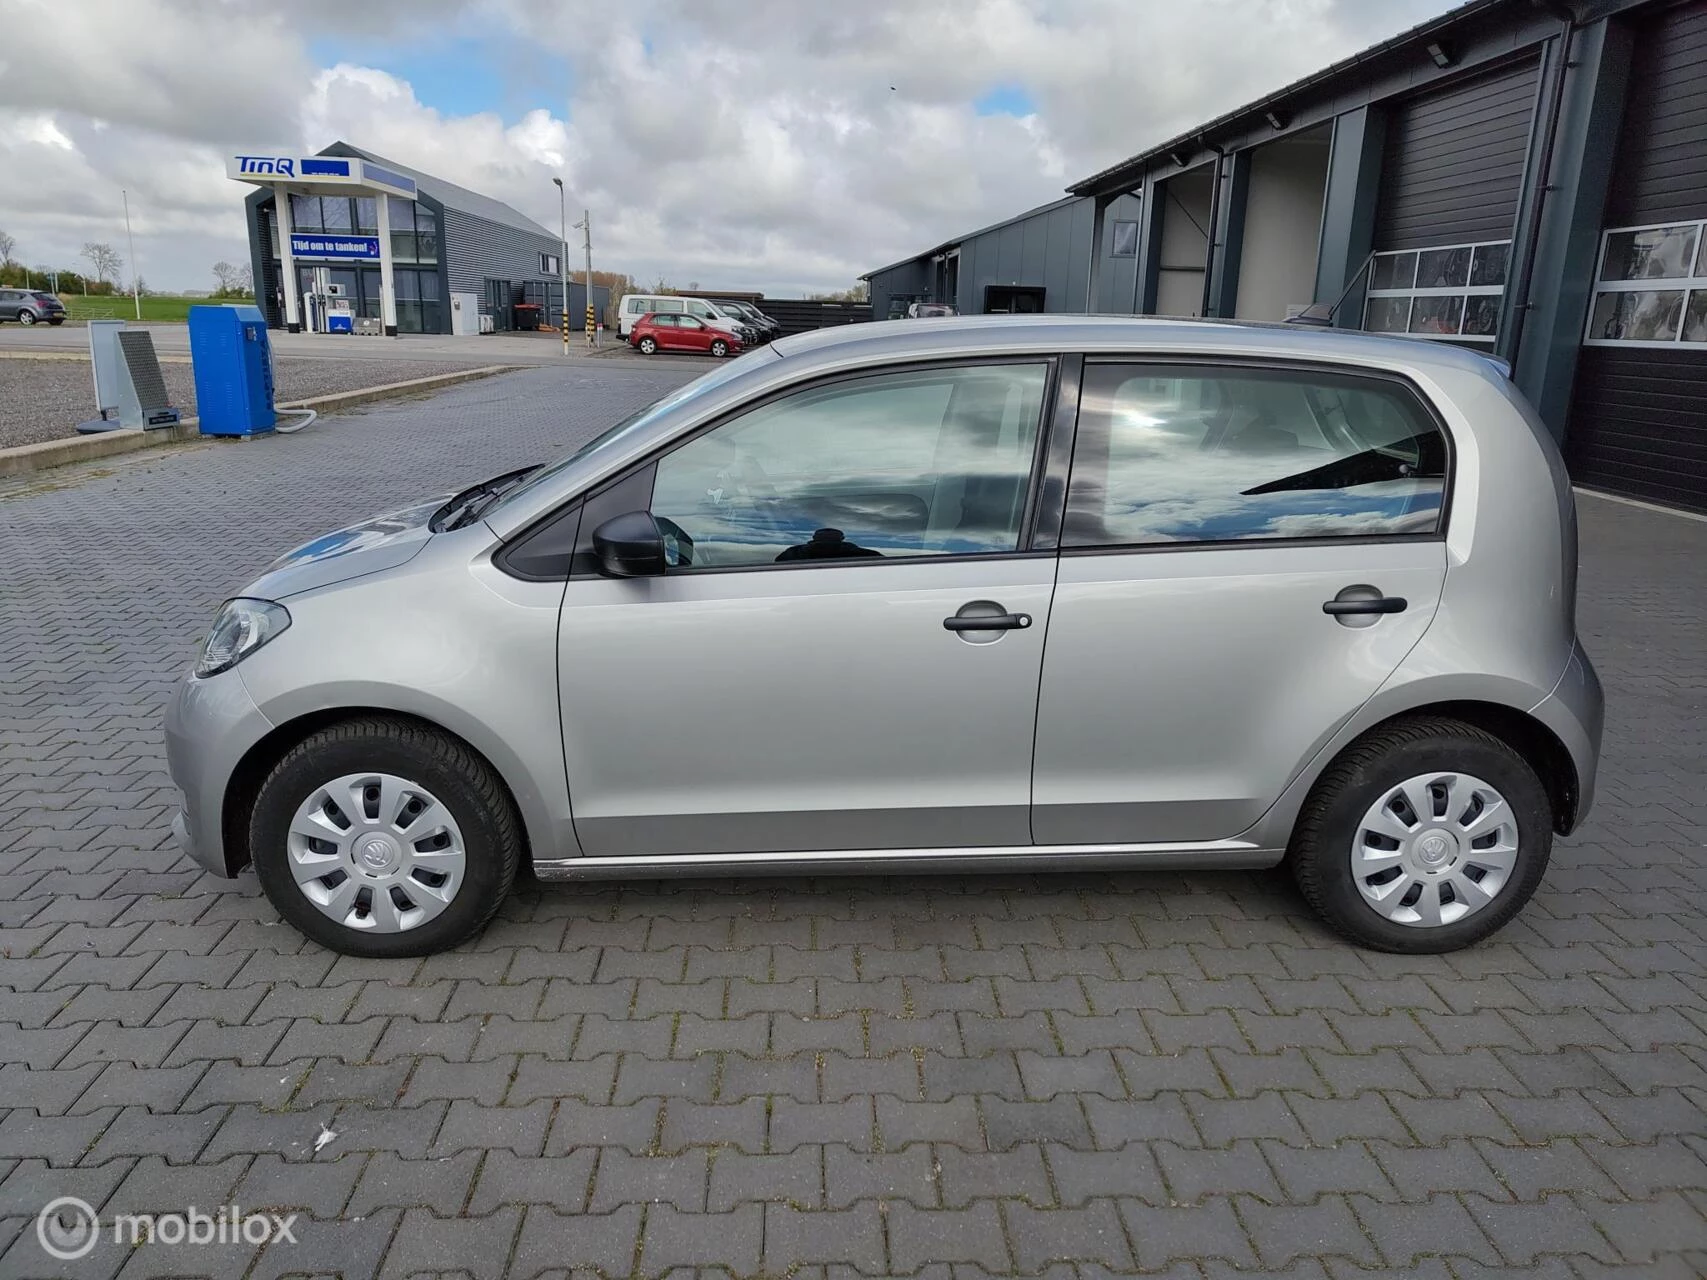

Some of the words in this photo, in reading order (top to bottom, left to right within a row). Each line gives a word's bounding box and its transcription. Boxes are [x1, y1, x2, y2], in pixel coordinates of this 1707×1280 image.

[292, 240, 309, 251] Tijd
[310, 242, 324, 251] om
[325, 241, 334, 251] te
[334, 242, 368, 252] tanken!
